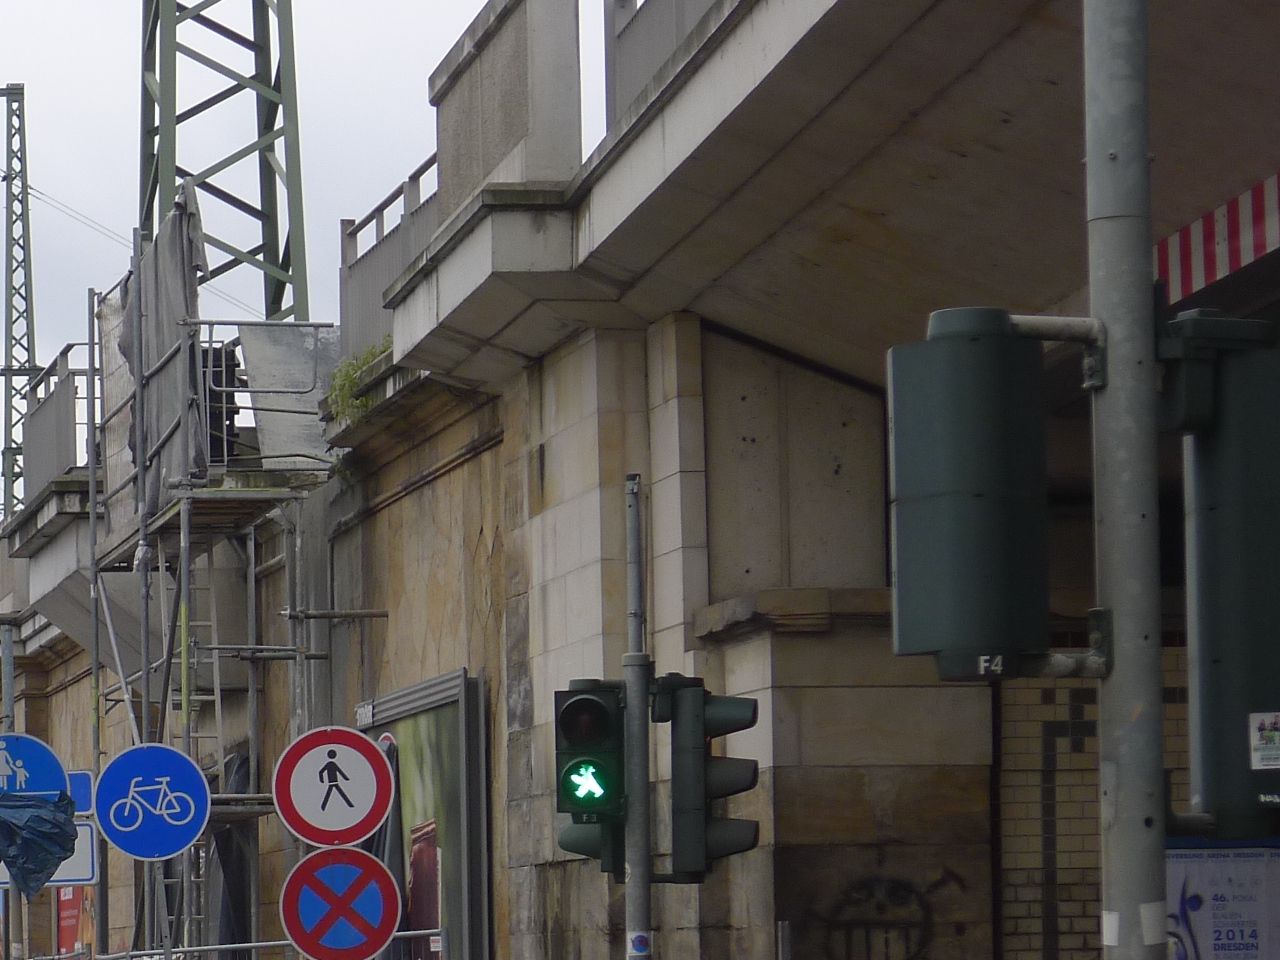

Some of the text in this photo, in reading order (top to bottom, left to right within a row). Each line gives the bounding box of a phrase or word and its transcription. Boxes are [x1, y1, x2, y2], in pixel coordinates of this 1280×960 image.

[980, 655, 1003, 675] F4
[1213, 929, 1259, 941] 2014
[1213, 943, 1259, 951] DRESDEN
